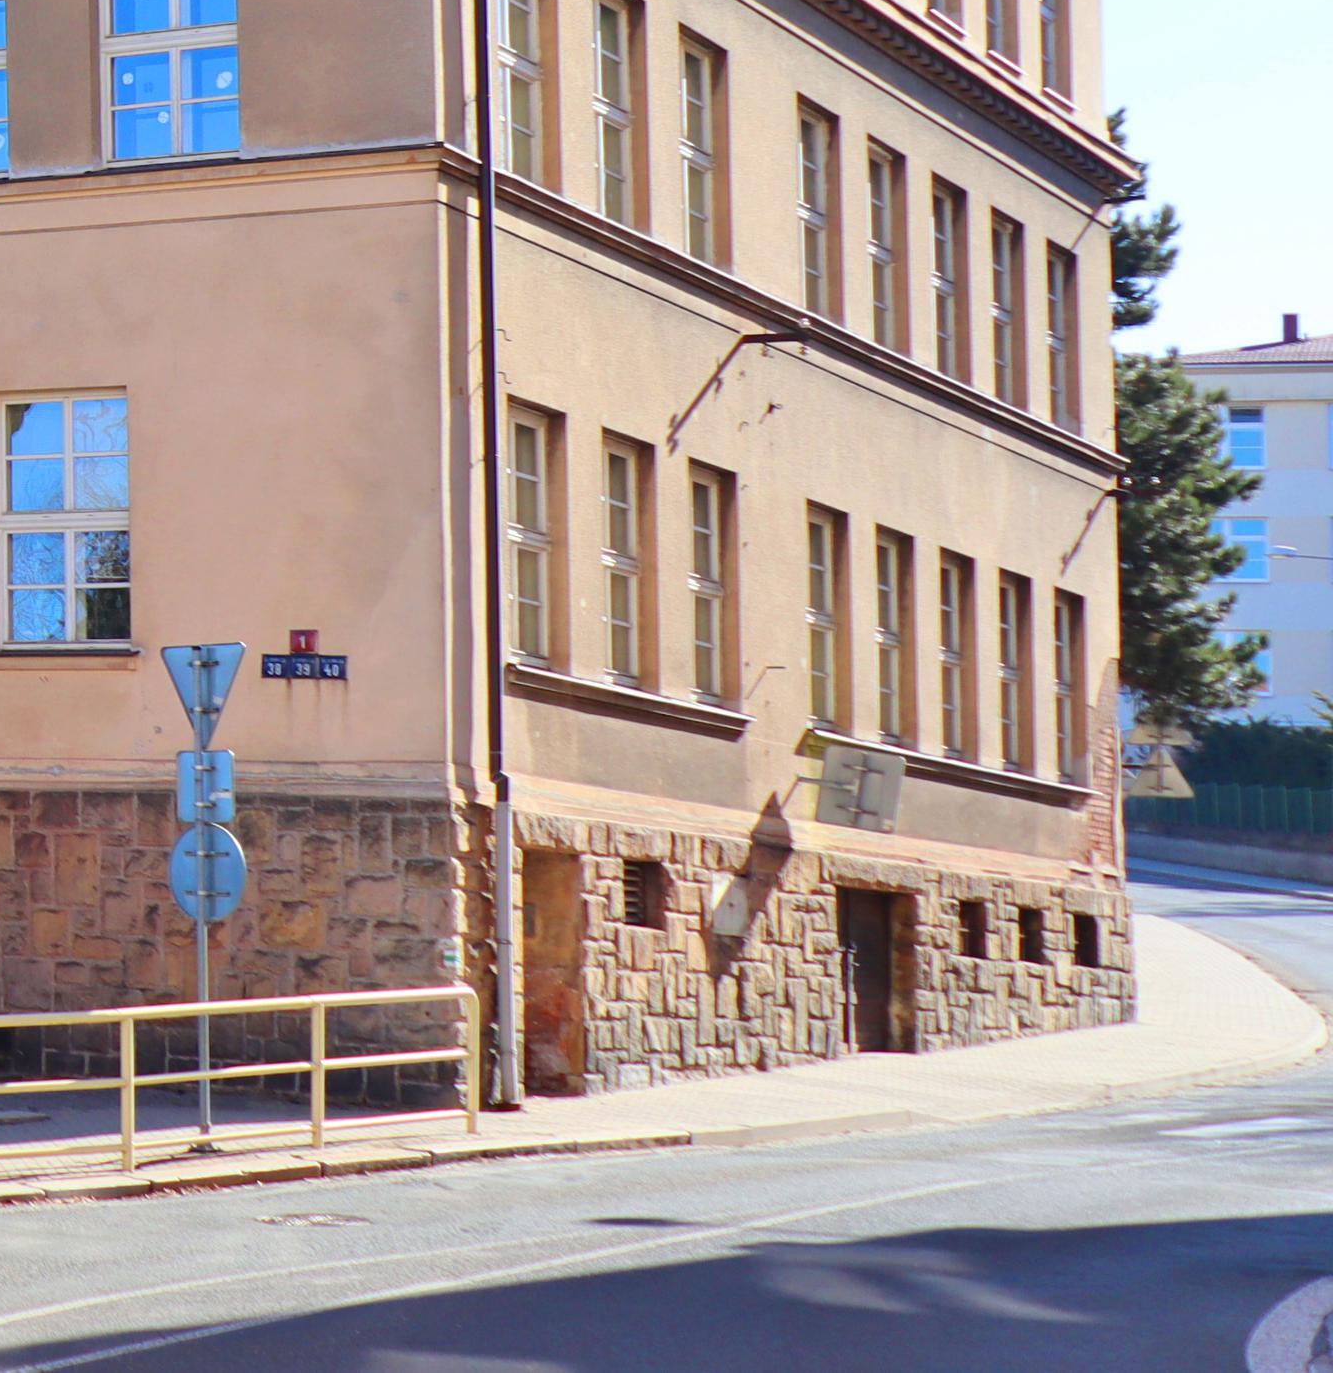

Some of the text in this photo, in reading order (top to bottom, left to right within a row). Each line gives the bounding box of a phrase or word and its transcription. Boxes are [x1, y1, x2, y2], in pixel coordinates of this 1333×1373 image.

[299, 635, 306, 649] 1
[267, 662, 282, 676] 38
[295, 663, 311, 676] 39
[323, 663, 340, 677] 40
